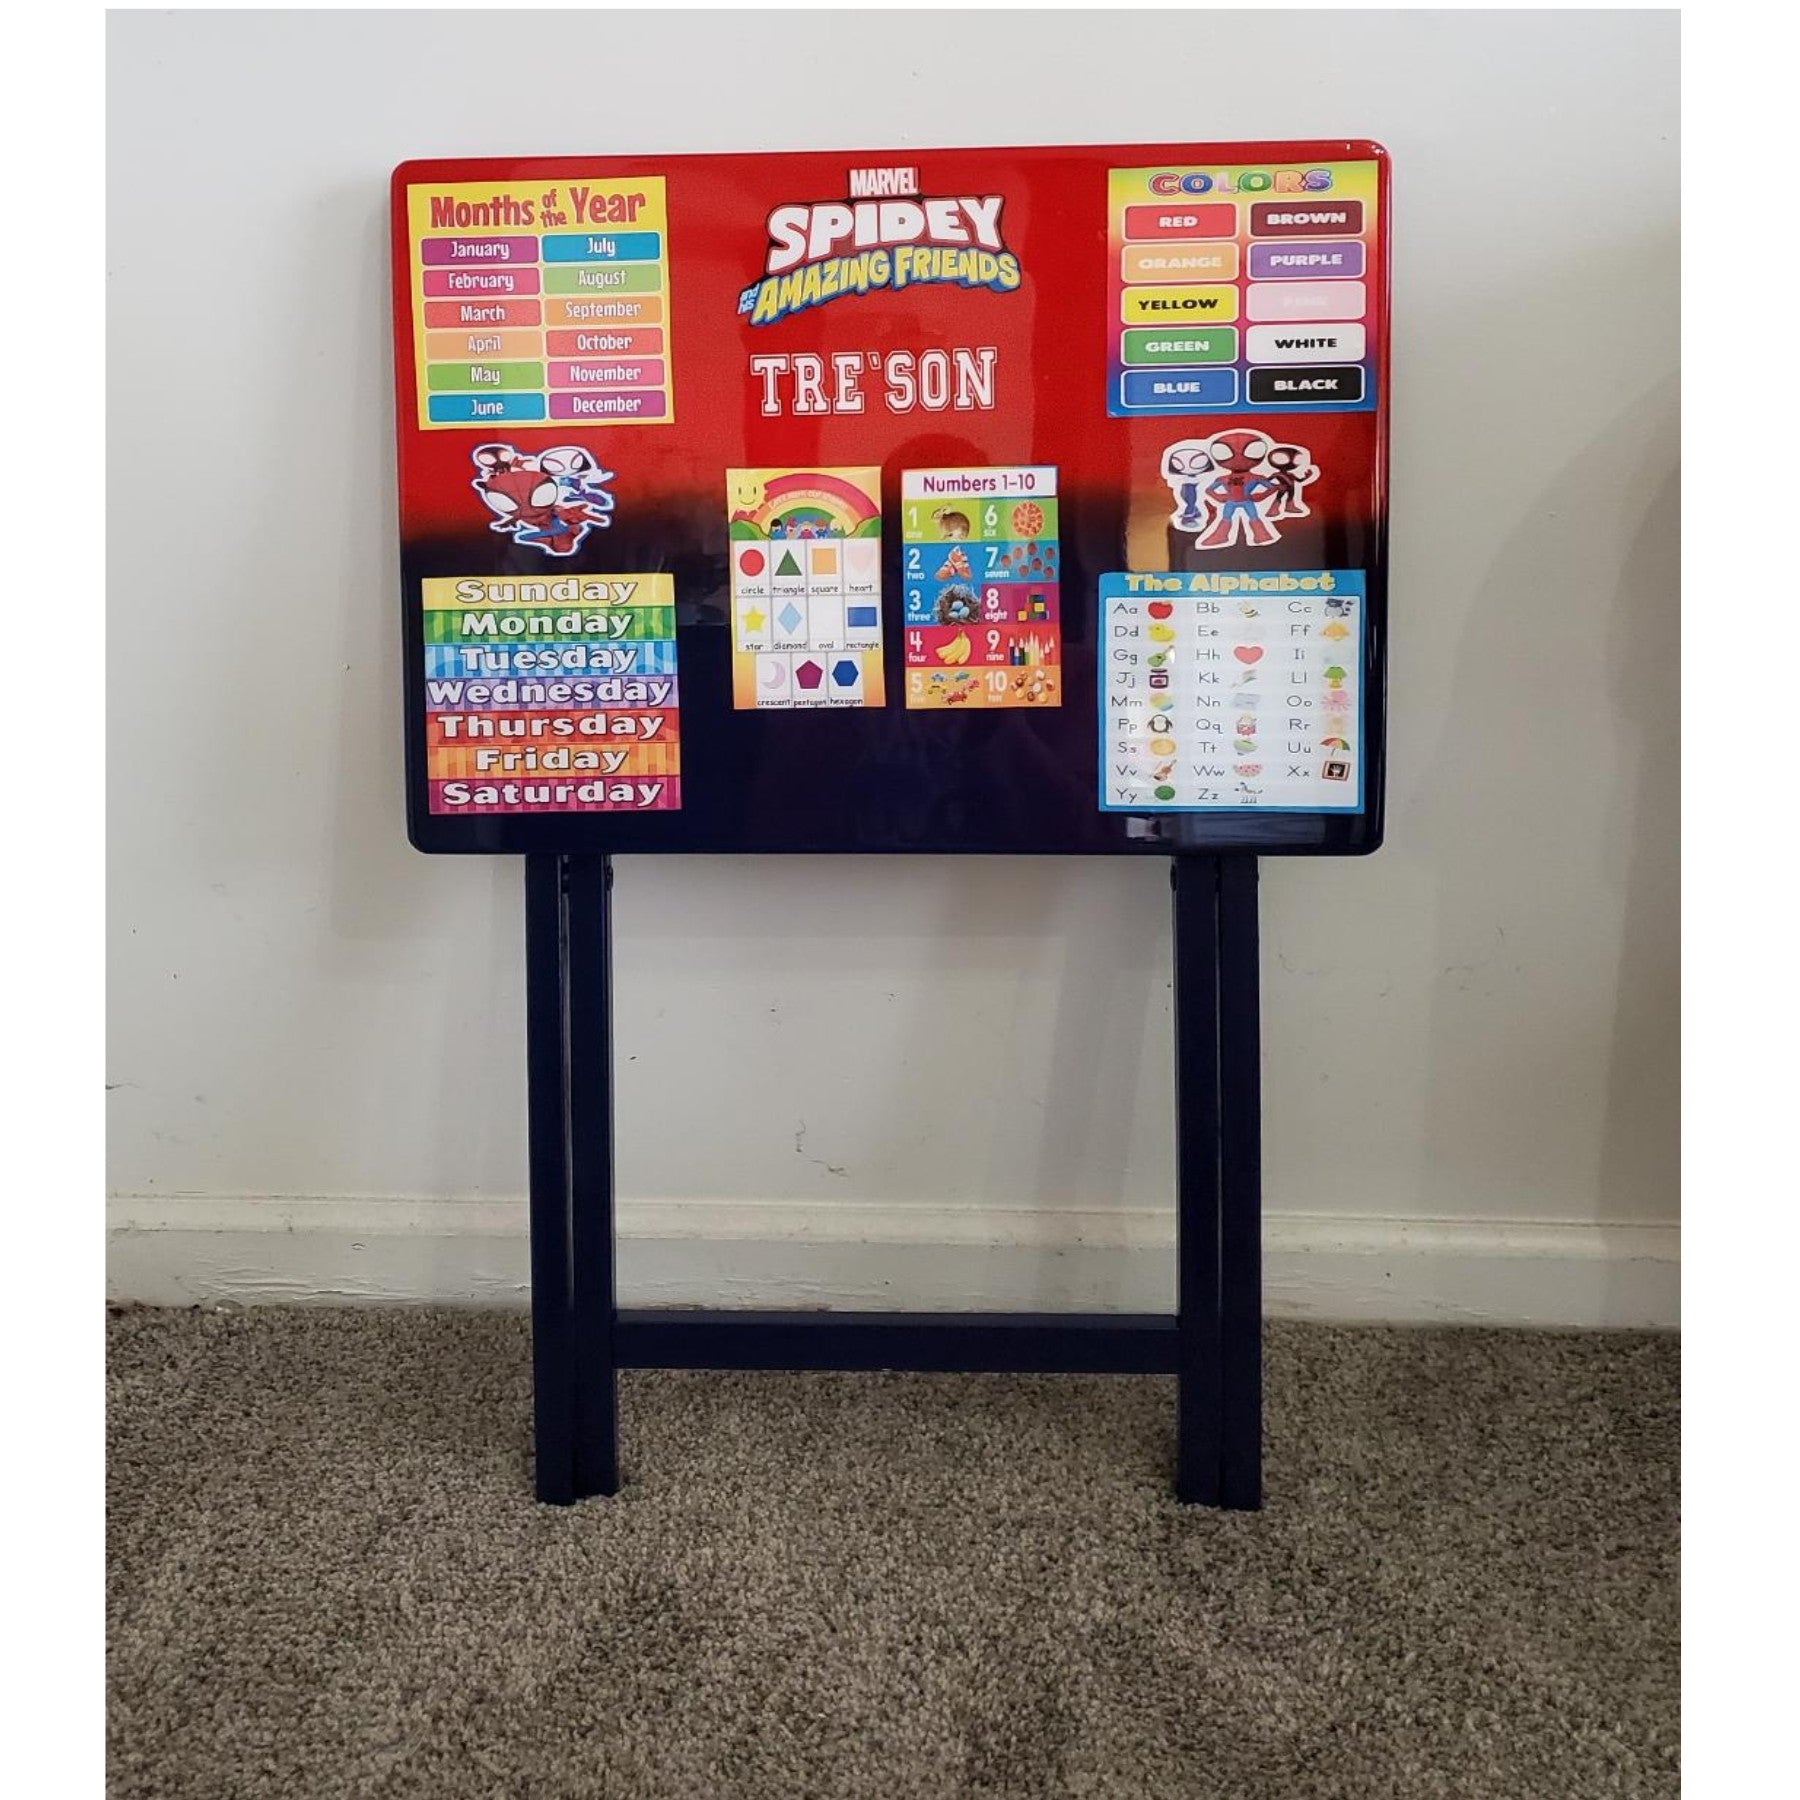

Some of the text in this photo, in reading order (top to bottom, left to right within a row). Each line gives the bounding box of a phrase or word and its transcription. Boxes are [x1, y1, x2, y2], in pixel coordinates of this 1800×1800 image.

[850, 168, 918, 196] MARVEL
[1149, 169, 1333, 195] COLORS
[430, 187, 646, 228] Months of the Year
[1159, 216, 1198, 228] RED
[1267, 213, 1346, 225] BROWN
[768, 196, 1003, 272] SPIDEY
[451, 241, 510, 258] January
[587, 239, 615, 257] July
[1139, 256, 1224, 270] ORANGE
[1270, 254, 1343, 267] PURPLE
[449, 273, 514, 290] February
[579, 270, 627, 288] August
[752, 250, 890, 324] AMAZING
[893, 247, 1020, 289] FRIENDS
[566, 301, 641, 319] September
[1139, 299, 1218, 310] YELLOW
[460, 305, 505, 322] March
[468, 335, 501, 353] April
[577, 334, 632, 350] October
[1145, 340, 1210, 353] GREEN
[1274, 338, 1337, 349] WHITE
[471, 367, 500, 385] May
[570, 365, 641, 381] November
[1153, 382, 1201, 394] BLUE
[1274, 379, 1338, 392] BLACK
[471, 399, 504, 416] June
[573, 397, 641, 413] December
[923, 476, 996, 493] Numbers
[908, 507, 917, 528] 1
[985, 505, 998, 525] 6
[908, 549, 920, 569] 2
[985, 547, 998, 567] 7
[741, 586, 764, 594] circle
[773, 586, 805, 595] triangle
[811, 586, 838, 594] square
[1126, 573, 1336, 594] The Alphabet
[456, 579, 638, 606] Sunday
[986, 588, 999, 609] 8
[909, 590, 921, 611] 3
[1288, 602, 1312, 614] Cc
[1113, 603, 1138, 614] Aa
[1196, 603, 1220, 614] Bb
[908, 613, 931, 621] three
[985, 611, 1007, 622] eight
[460, 611, 634, 638] Monday
[1114, 625, 1139, 637] Dd
[1198, 626, 1219, 637] Ee
[1291, 625, 1310, 636] Ff
[910, 632, 922, 651] 4
[986, 630, 1000, 651] 9
[460, 646, 638, 673] Tuesday
[908, 653, 927, 662] four
[986, 652, 1004, 661] nine
[1114, 650, 1138, 665] Gg
[1196, 649, 1220, 661] Hh
[1294, 648, 1304, 660] Ii
[911, 673, 923, 693] 5
[985, 671, 1007, 692] 10
[1116, 673, 1135, 688] Jj
[1199, 673, 1220, 684] Kk
[1292, 673, 1307, 683] Ll
[428, 679, 672, 706] Wednesday
[1112, 697, 1142, 707] Mm
[1197, 696, 1220, 707] Nn
[1287, 696, 1312, 707] Oo
[437, 713, 665, 740] Thursday
[1118, 719, 1137, 734] Pp
[1196, 719, 1223, 734] Qq
[1289, 719, 1310, 730] Rr
[1118, 743, 1136, 753] Ss
[1200, 742, 1215, 753] Tt
[1288, 743, 1311, 753] Uu
[476, 746, 629, 774] Friday
[1116, 765, 1137, 776] Vv
[1194, 766, 1225, 776] Ww
[1288, 766, 1310, 777] Xx
[443, 781, 663, 807] Saturday
[1116, 788, 1137, 803] Yy
[1198, 789, 1219, 800] Zz
